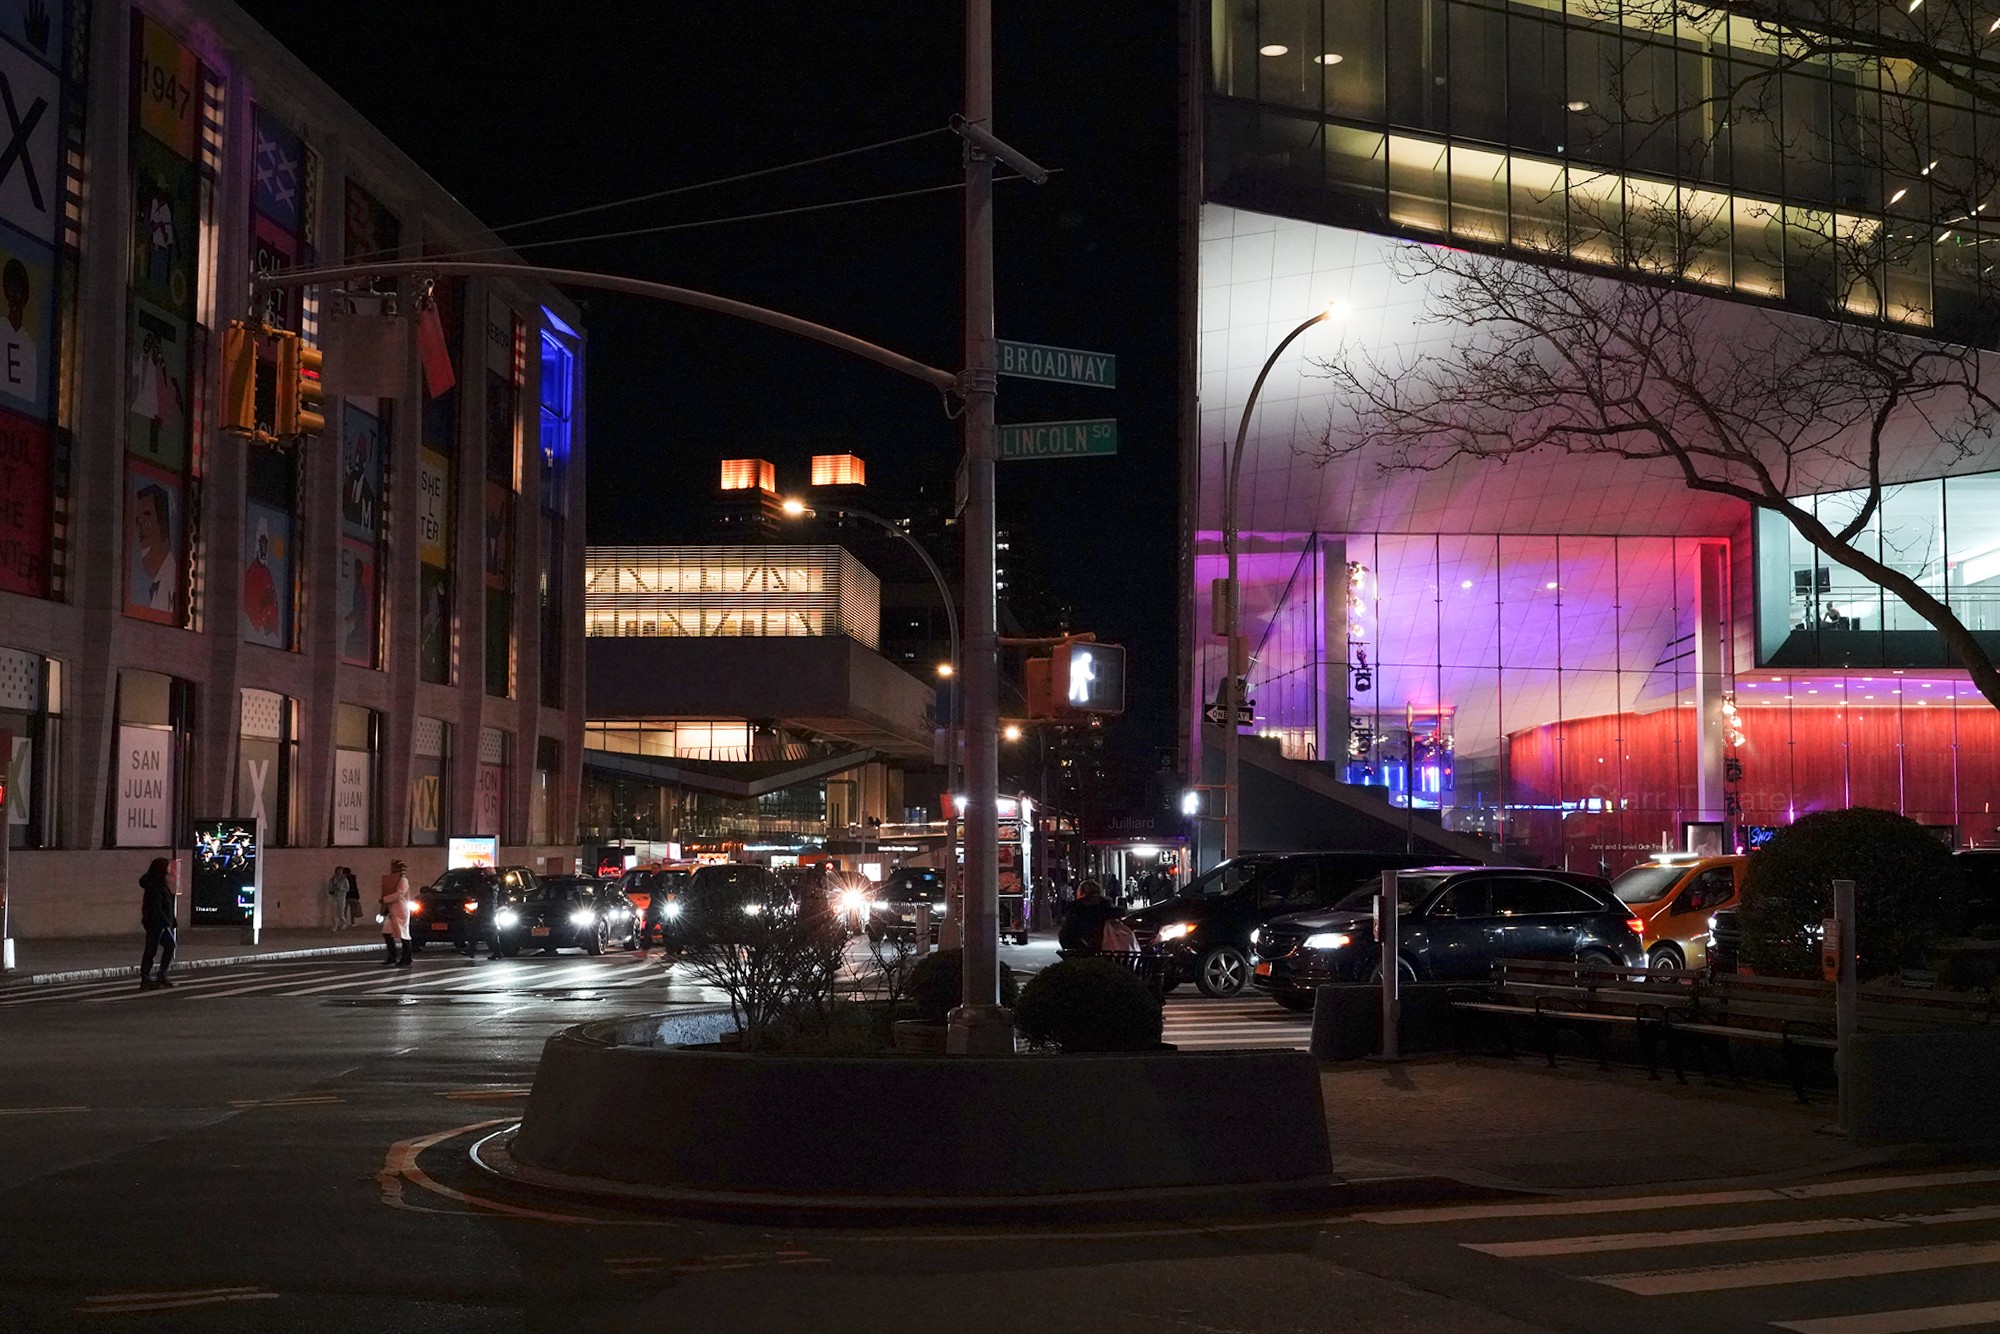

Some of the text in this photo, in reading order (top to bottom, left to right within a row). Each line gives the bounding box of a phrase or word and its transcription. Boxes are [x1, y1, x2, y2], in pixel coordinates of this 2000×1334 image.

[140, 57, 190, 120] 1947
[7, 342, 21, 384] E
[1003, 345, 1108, 383] BROADWAY
[1003, 424, 1111, 456] LINCOLN SQ
[421, 471, 441, 498] SHE
[420, 516, 440, 542] TER
[131, 750, 160, 771] SAN
[342, 768, 361, 785] SAN
[125, 779, 162, 799] JUAN
[1589, 784, 1665, 811] Starr
[337, 792, 362, 808] JUAN
[127, 808, 158, 829] HILL
[339, 815, 360, 831] HILL
[1108, 816, 1155, 829] Juilliard
[195, 905, 218, 913] Theater
